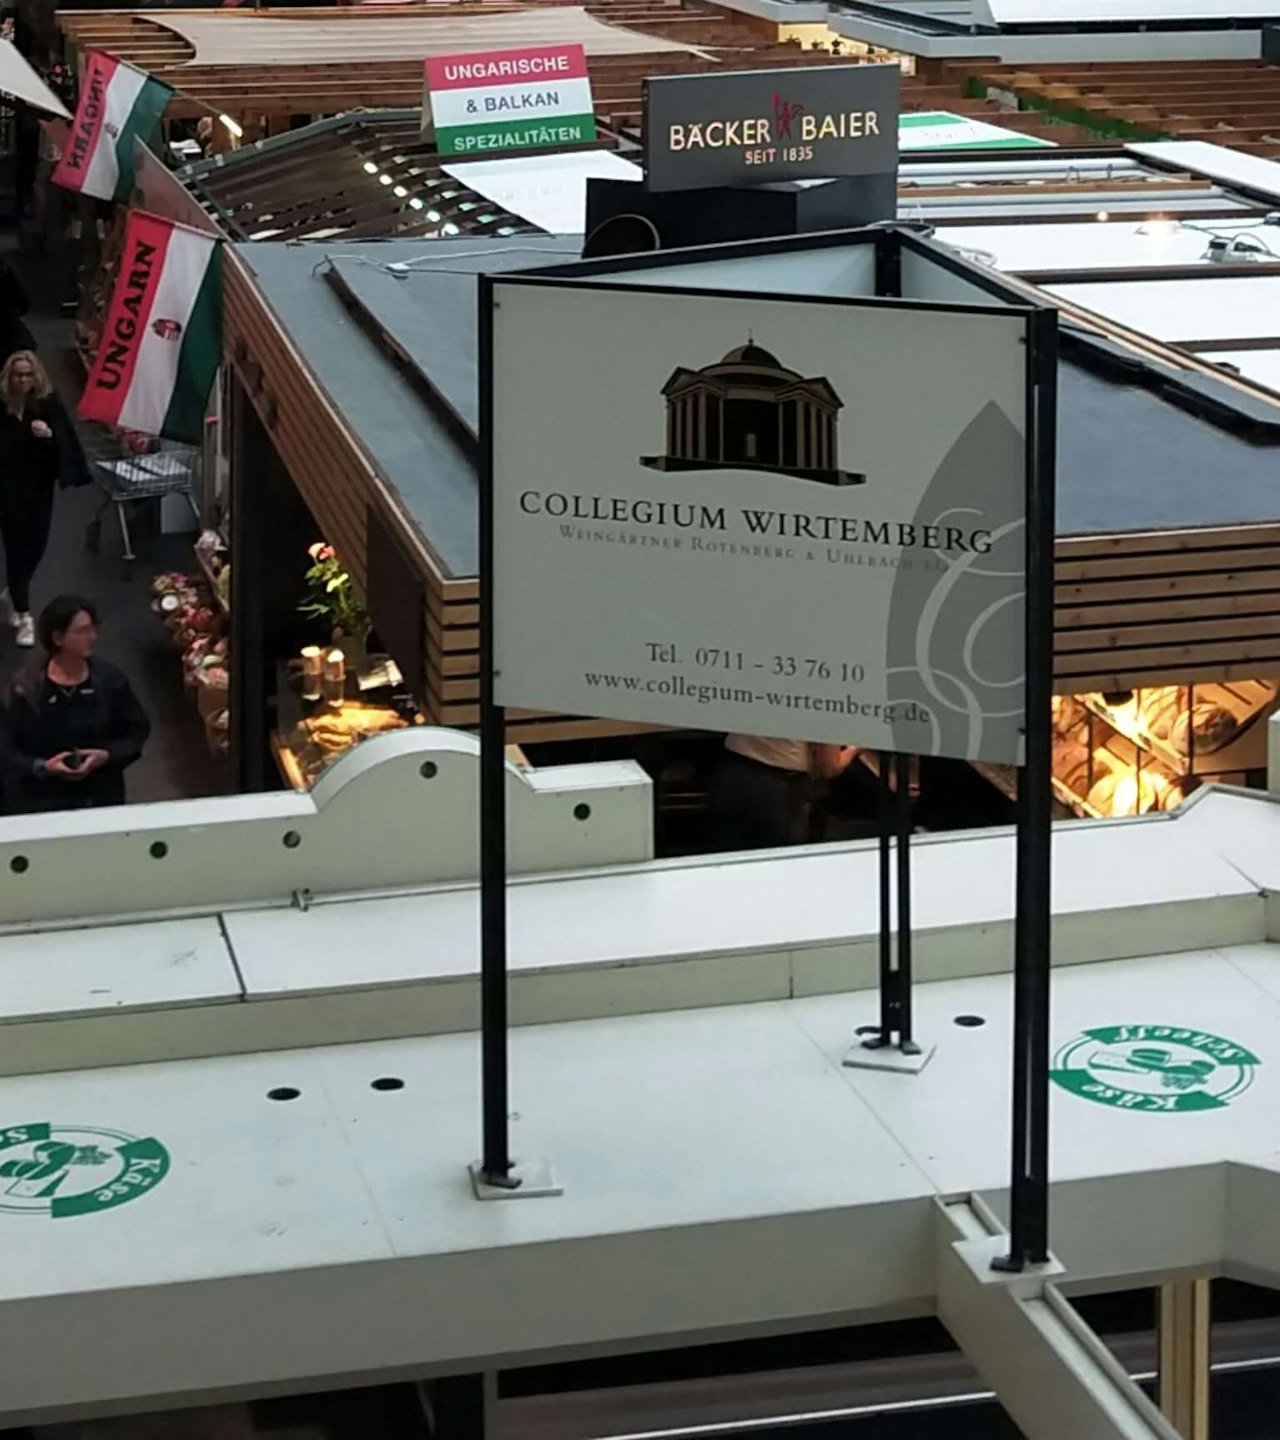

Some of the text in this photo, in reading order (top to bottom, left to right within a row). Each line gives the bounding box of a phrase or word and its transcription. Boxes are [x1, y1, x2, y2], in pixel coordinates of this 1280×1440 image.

[444, 55, 570, 81] UNGARISCHE
[466, 91, 560, 113] & BALKAN
[453, 124, 581, 152] SPEZIALITÄTEN
[669, 111, 880, 151] BÄCKER BAIER
[745, 146, 813, 165] SEIT 1835
[96, 239, 157, 391] UNGARN
[519, 490, 994, 555] COLLEGIUM WIRTEMBERG
[646, 642, 683, 664] Tel.
[694, 647, 745, 671] 0711
[771, 655, 797, 677] 33
[804, 659, 831, 680] 76
[840, 662, 865, 683] 10
[1080, 1081, 1181, 1111] Käse
[96, 1157, 163, 1203] Käse
